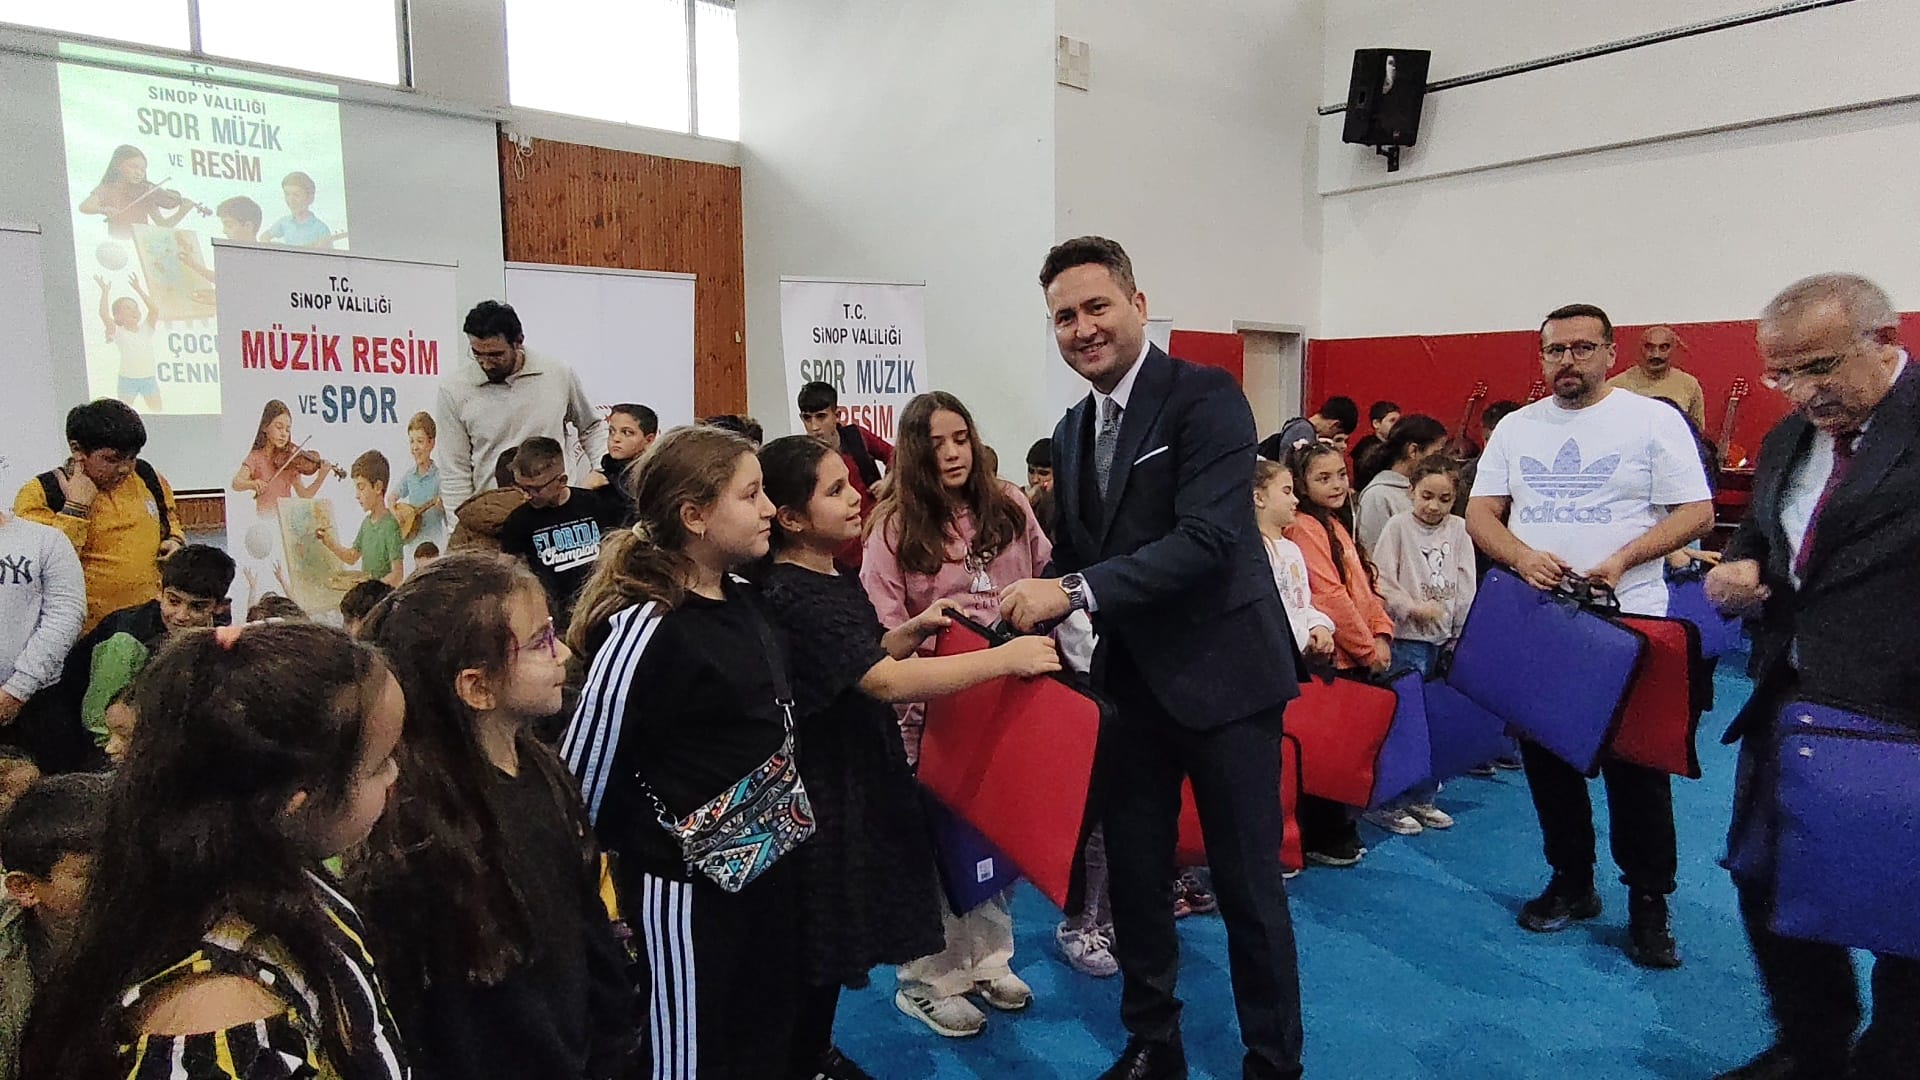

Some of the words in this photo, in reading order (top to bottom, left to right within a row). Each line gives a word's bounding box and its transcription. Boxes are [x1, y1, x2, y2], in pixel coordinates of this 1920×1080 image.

[137, 107, 200, 141] SPOR
[211, 115, 283, 151] MÜZİK
[168, 153, 184, 168] VE
[190, 148, 262, 183] RESİM
[329, 276, 354, 293] T.C.
[843, 304, 867, 320] T.C.
[241, 323, 343, 372] MÜZİK
[352, 330, 439, 375] RESİM
[800, 359, 846, 394] SPOR
[856, 354, 916, 394] MÜZİK
[298, 395, 318, 414] VE
[321, 384, 399, 424] SPOR
[1520, 501, 1612, 524] adidas
